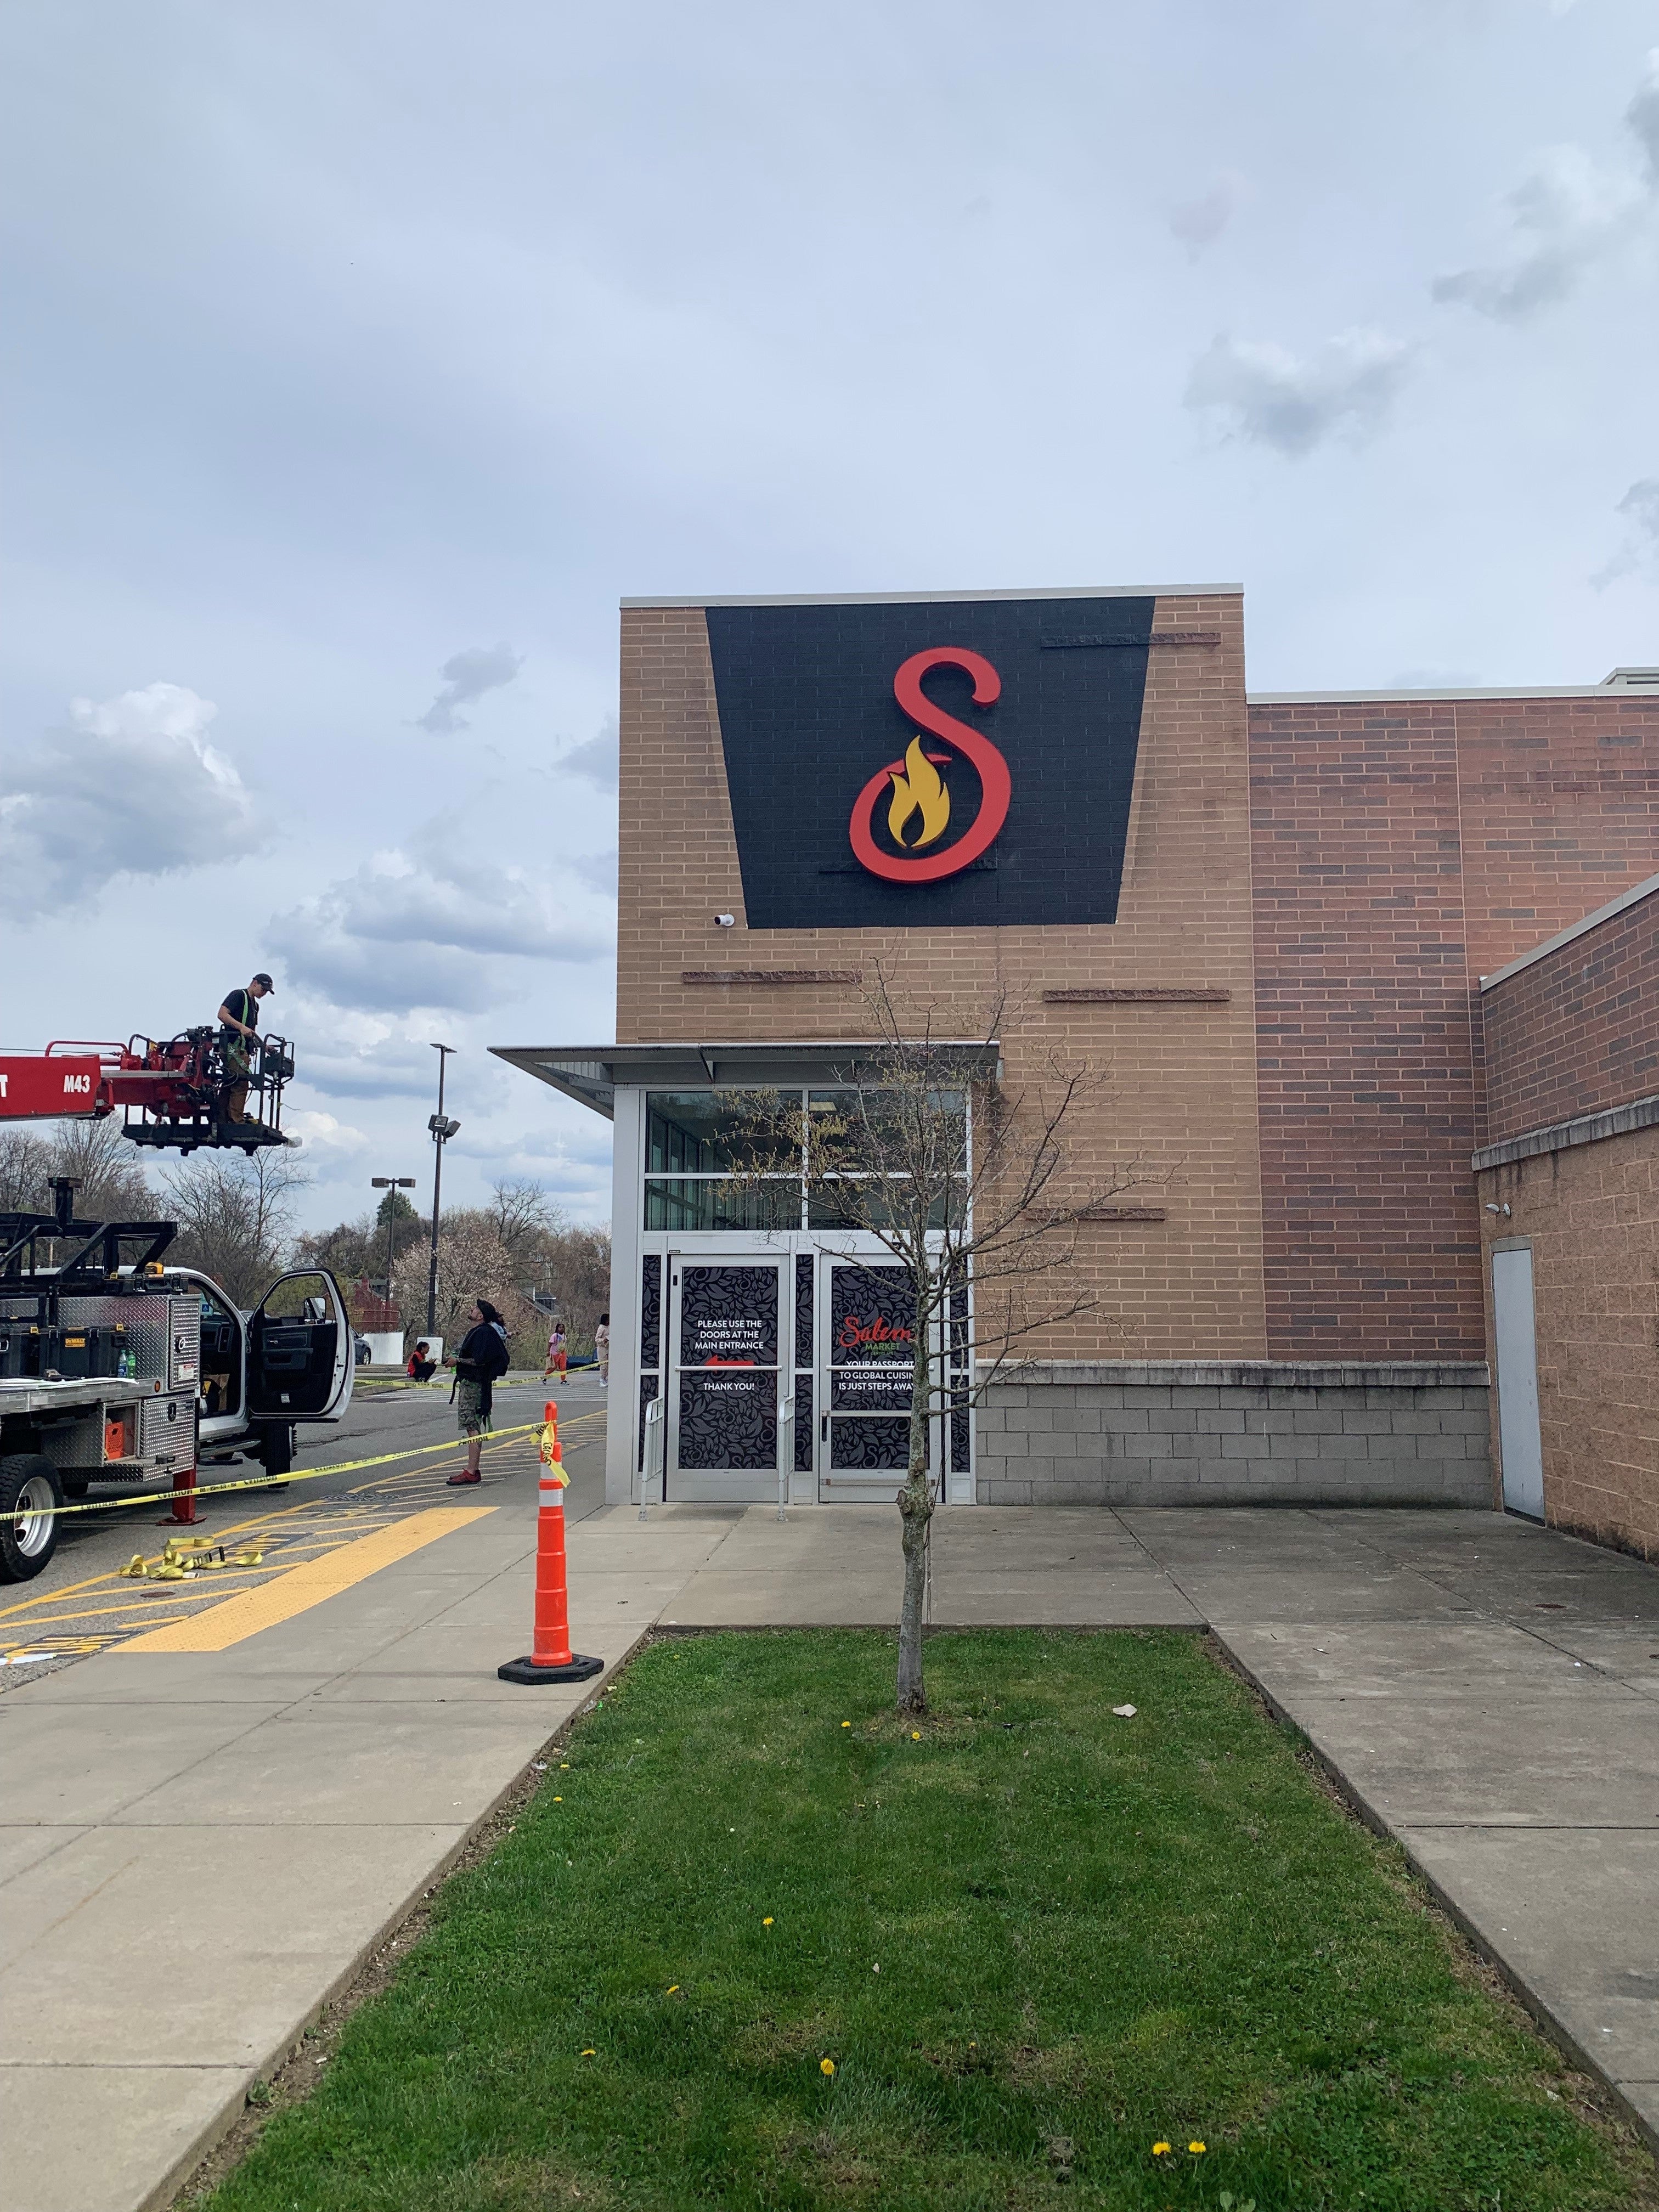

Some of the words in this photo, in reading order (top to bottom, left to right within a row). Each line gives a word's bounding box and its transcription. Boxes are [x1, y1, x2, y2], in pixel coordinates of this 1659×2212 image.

[849, 646, 1011, 884] S
[63, 1075, 90, 1093] M43
[839, 1316, 915, 1348] Salem
[695, 1341, 718, 1350] MAIN
[719, 1341, 764, 1350] ENTRANCE
[839, 1372, 851, 1380] TO
[853, 1372, 885, 1380] GLOBAL
[887, 1372, 913, 1380] CUISIN
[839, 1382, 846, 1390] IS
[848, 1382, 866, 1390] JUST
[868, 1382, 891, 1390] STEPS
